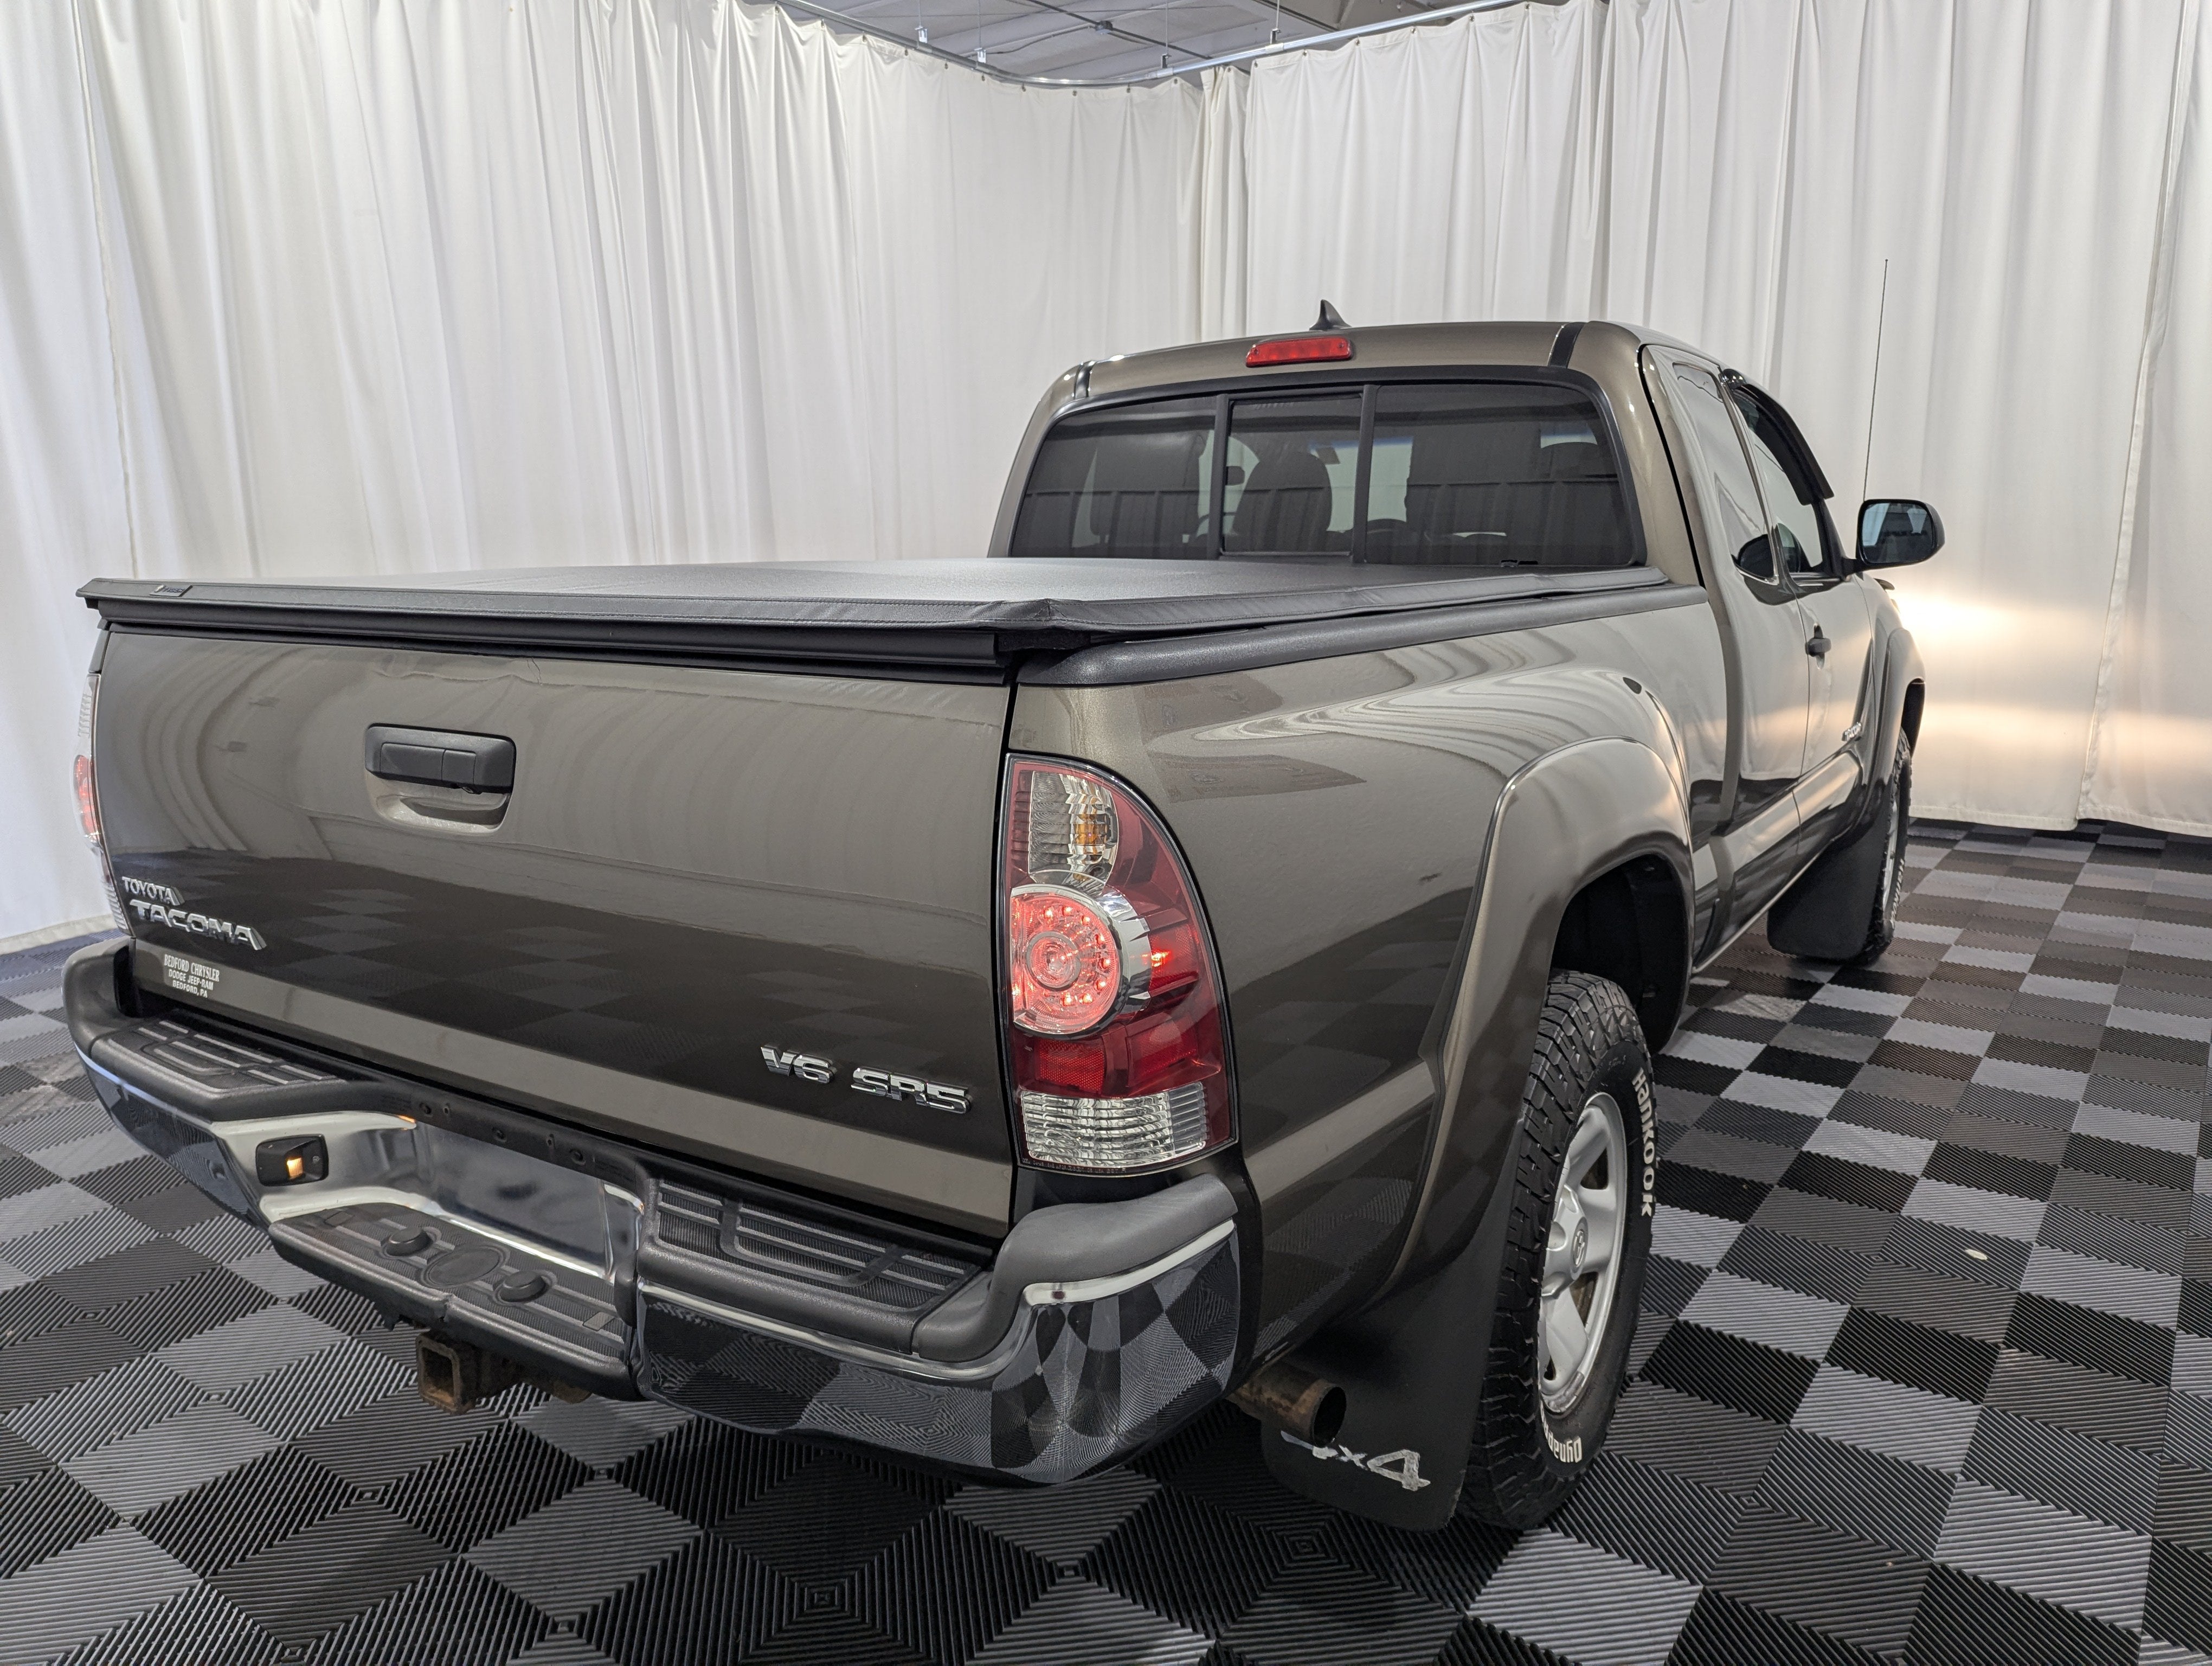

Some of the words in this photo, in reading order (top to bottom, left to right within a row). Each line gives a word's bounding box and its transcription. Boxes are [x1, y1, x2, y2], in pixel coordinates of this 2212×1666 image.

[122, 876, 182, 906] TOYOTA
[130, 899, 265, 950] TACOMA
[164, 954, 189, 972] BEDFORD
[191, 963, 220, 982] CHRYSLER
[169, 969, 187, 982] DODGE
[173, 980, 199, 996] BEDFORD,
[200, 989, 208, 998] PA
[761, 1046, 835, 1084] V6
[851, 1066, 972, 1114] SR5
